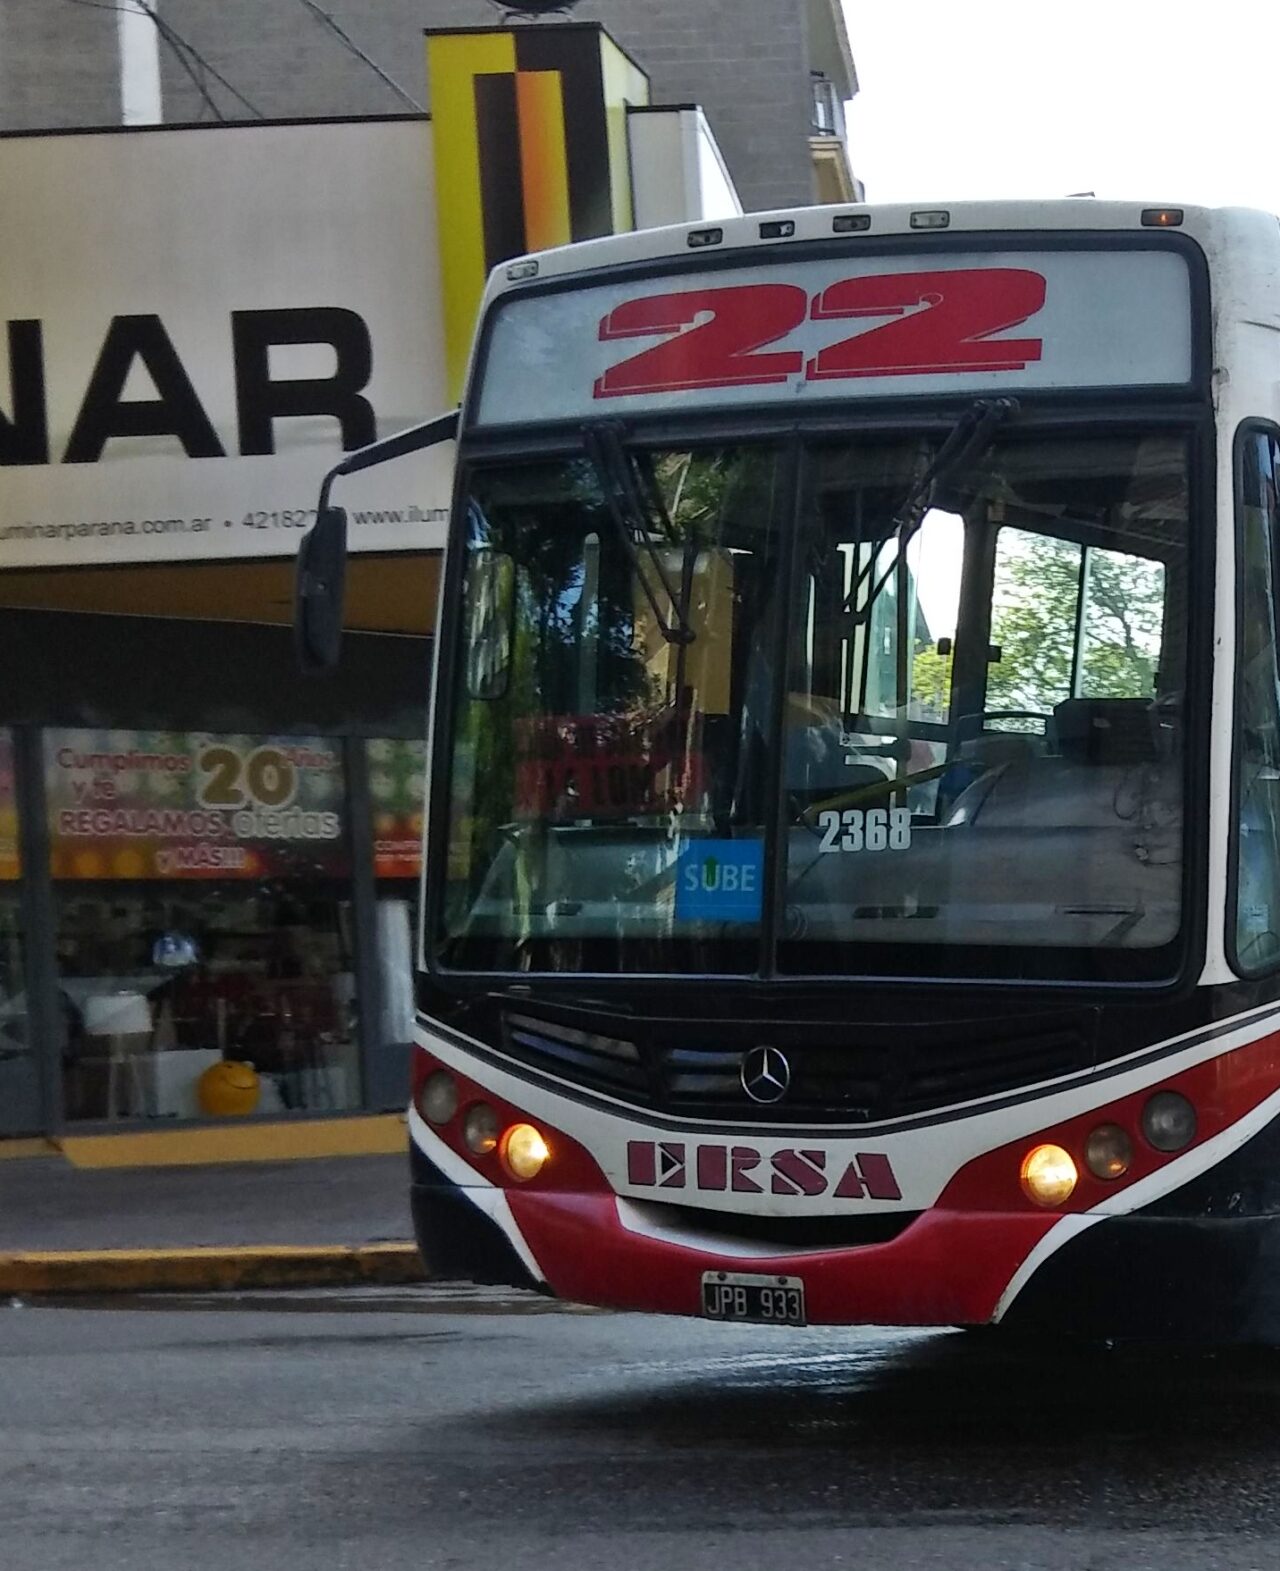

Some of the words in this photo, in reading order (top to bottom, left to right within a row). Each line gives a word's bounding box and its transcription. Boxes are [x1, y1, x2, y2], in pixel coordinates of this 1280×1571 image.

[594, 267, 1047, 399] 22
[242, 510, 317, 529] 42182
[57, 748, 191, 772] Cumplimos
[197, 745, 297, 808] 20
[93, 777, 115, 800] te
[232, 806, 341, 839] ofertas
[818, 808, 911, 853] 2368
[684, 863, 756, 892] SUBE
[627, 1139, 904, 1200] ERSA
[707, 1286, 747, 1316] JPB
[761, 1289, 800, 1319] 933
